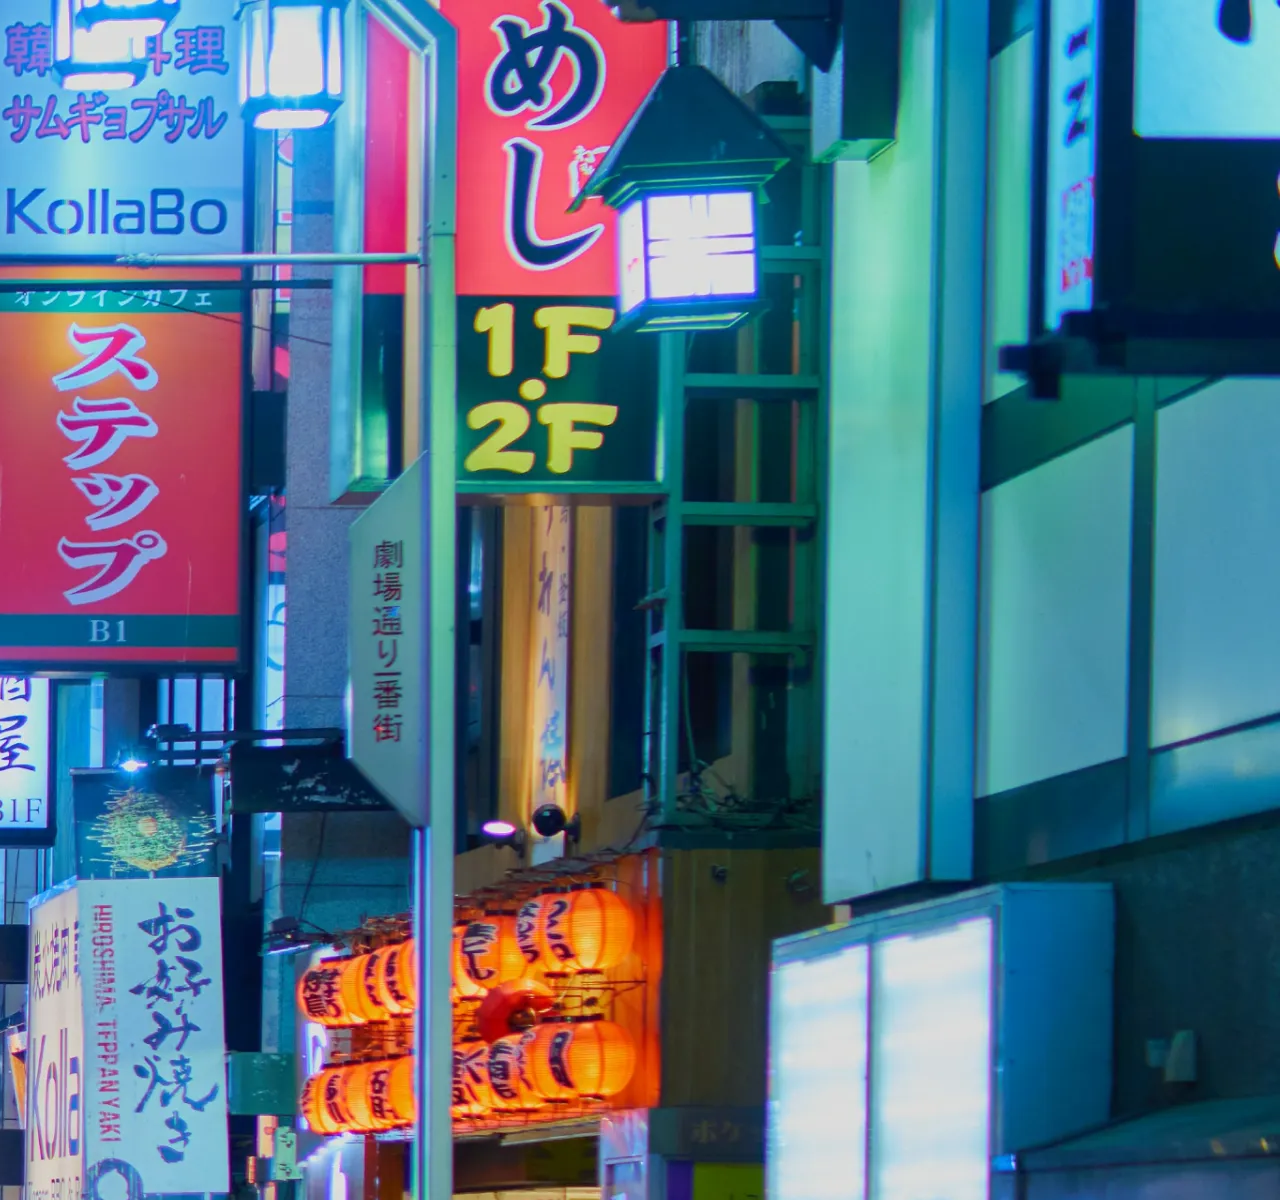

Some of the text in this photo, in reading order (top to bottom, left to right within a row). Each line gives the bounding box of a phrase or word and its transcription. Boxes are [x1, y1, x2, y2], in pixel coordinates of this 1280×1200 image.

[4, 22, 230, 77] 韓理
[3, 90, 228, 144] サムギョプサル
[484, 0, 606, 271] めし
[5, 187, 228, 235] KollaBo
[473, 303, 616, 379] 1F
[52, 323, 168, 605] ステップ
[464, 401, 618, 474] 2F
[89, 620, 128, 643] B1
[373, 539, 404, 743] 劇場通り一番街
[92, 904, 115, 1012] HIROSHIMA
[128, 902, 221, 1163] お好み焼き
